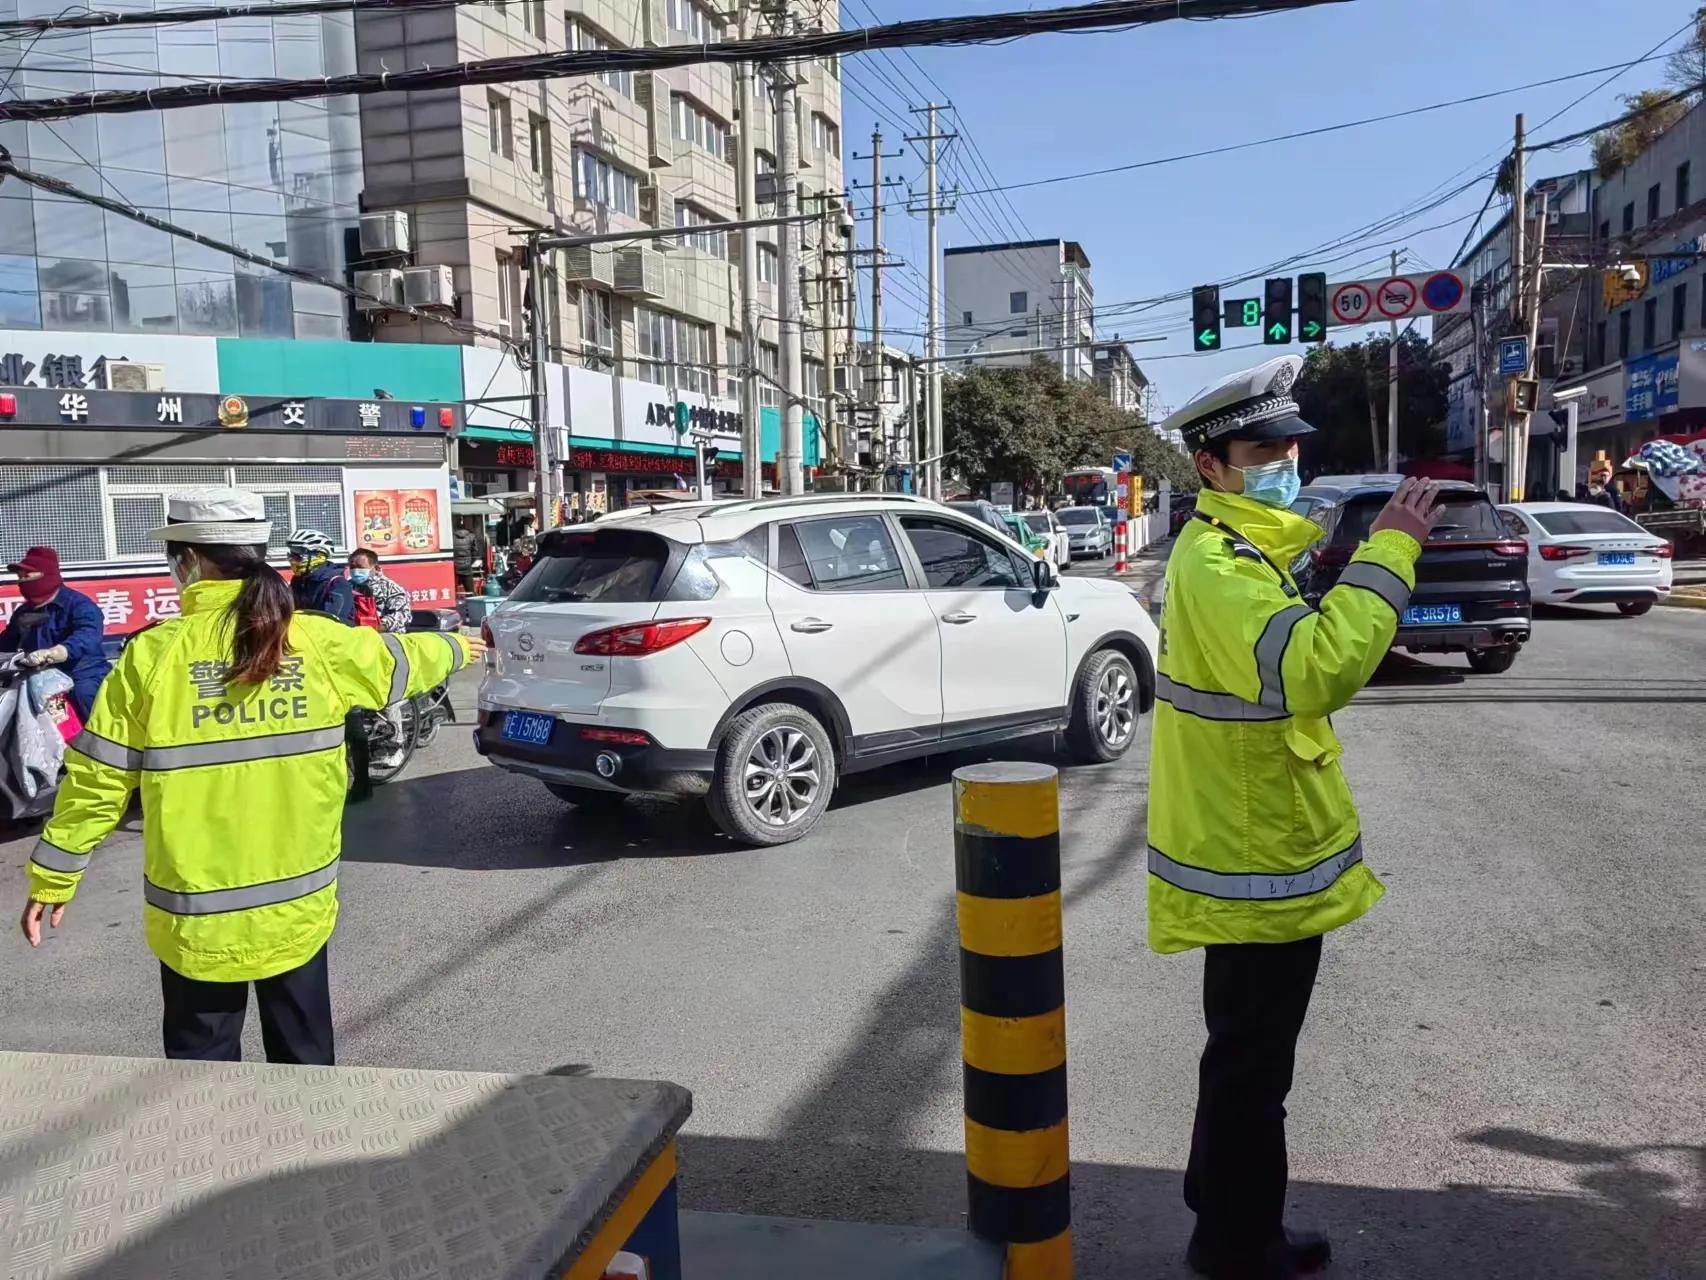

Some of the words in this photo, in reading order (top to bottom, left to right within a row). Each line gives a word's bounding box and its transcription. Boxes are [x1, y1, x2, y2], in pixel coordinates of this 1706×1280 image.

[1243, 301, 1259, 325] 8
[1341, 294, 1361, 312] 50
[645, 402, 675, 428] ABC
[191, 696, 307, 729] POLICE
